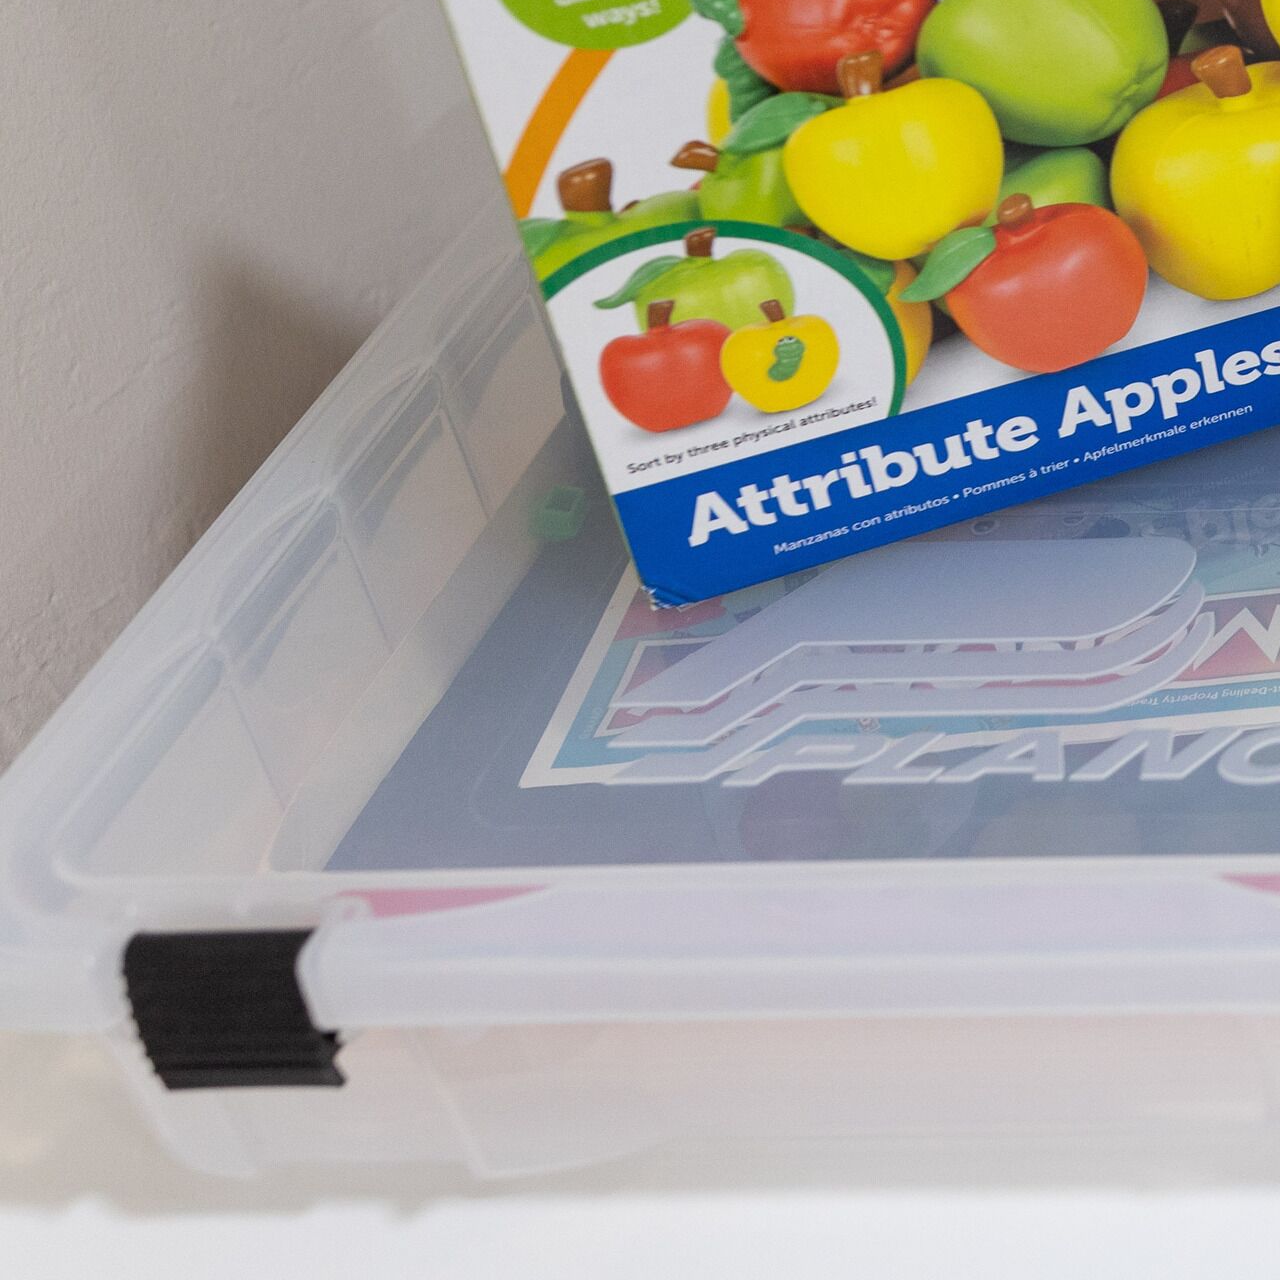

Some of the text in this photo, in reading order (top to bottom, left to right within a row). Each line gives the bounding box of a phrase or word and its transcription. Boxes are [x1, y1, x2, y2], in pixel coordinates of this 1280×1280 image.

[627, 396, 878, 475] Sort by three physical attributes!
[688, 410, 1040, 546] Attribute
[773, 524, 850, 556] Manzanas
[851, 517, 882, 534] con
[883, 493, 950, 522] atributos
[962, 473, 1026, 499] Pommes
[1040, 456, 1071, 476] trier
[1083, 424, 1188, 463] Apfelmerkmale
[1188, 405, 1254, 431] erkennen
